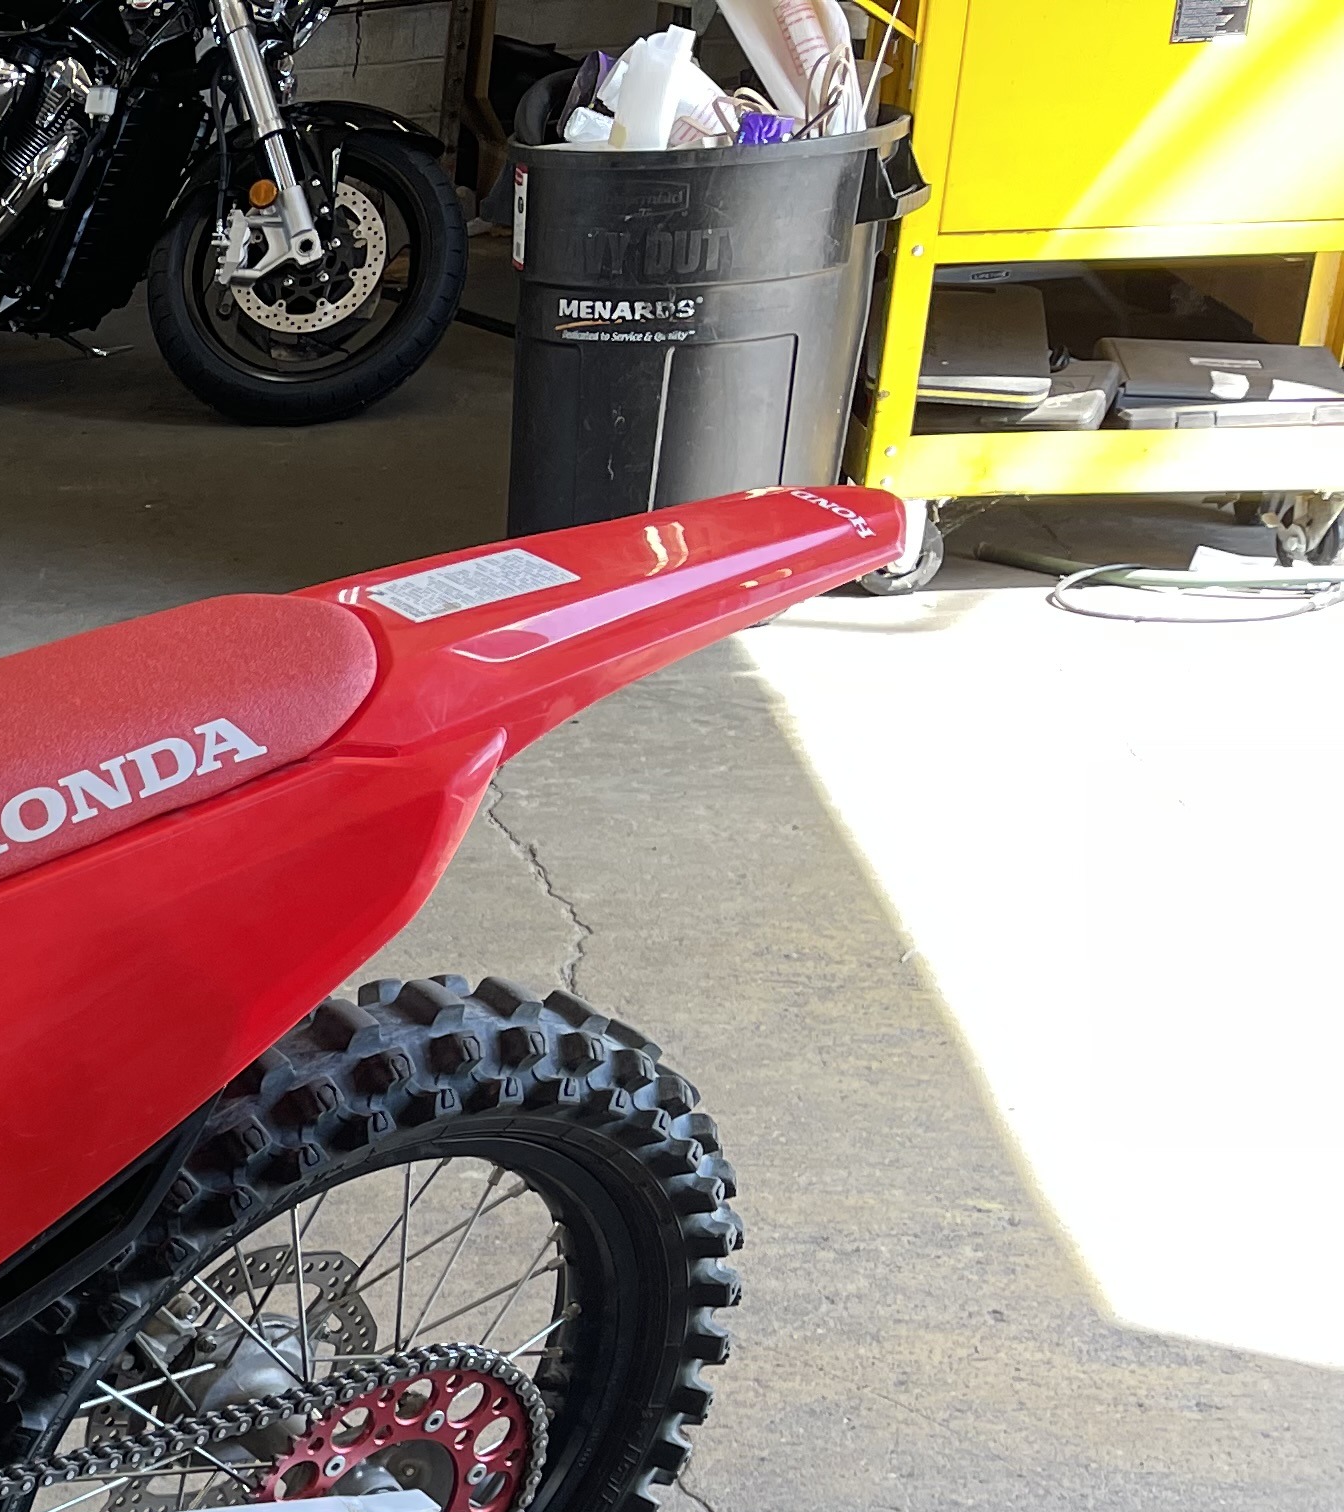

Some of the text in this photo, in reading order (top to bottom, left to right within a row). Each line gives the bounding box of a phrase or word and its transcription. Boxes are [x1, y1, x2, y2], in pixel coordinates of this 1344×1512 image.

[559, 299, 695, 321] MENARDS
[601, 331, 610, 341] to
[611, 331, 643, 342] Service
[644, 332, 652, 342] &
